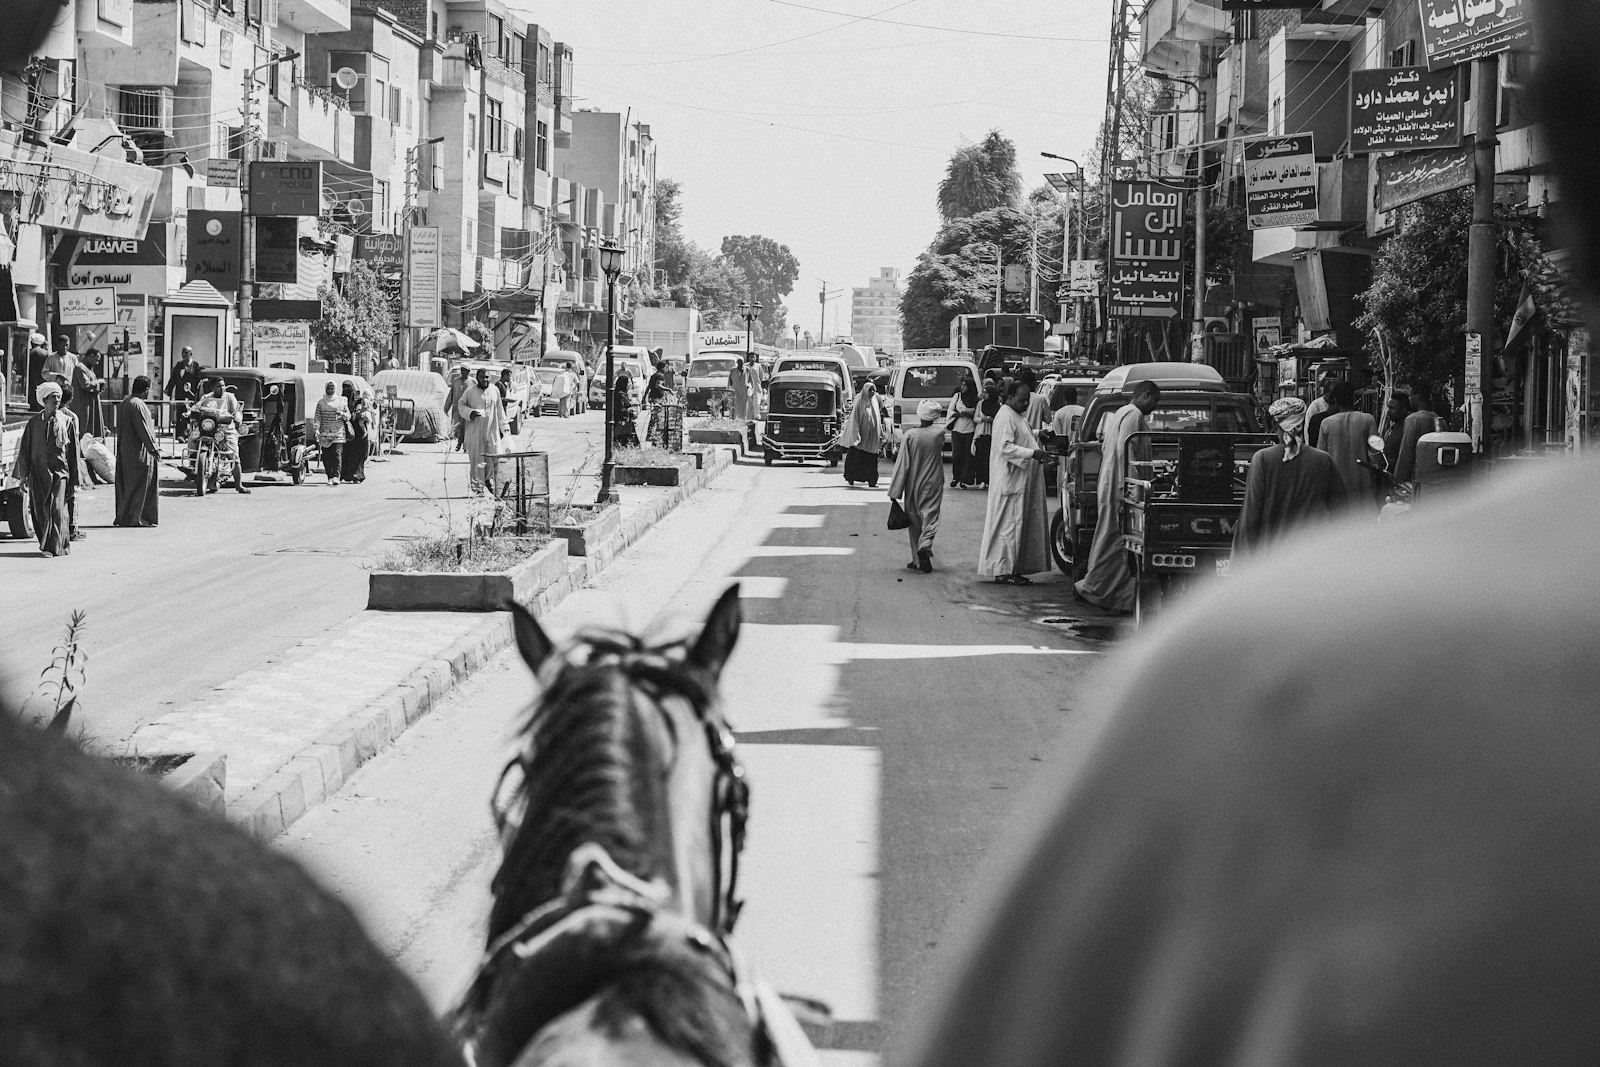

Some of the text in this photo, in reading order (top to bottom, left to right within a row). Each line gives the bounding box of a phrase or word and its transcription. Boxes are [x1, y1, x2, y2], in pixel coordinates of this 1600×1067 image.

[1436, 28, 1473, 46] الطبية
[1387, 70, 1420, 86] دكتور
[1355, 80, 1454, 109] أيمن محمد داود
[1375, 111, 1405, 123] الحميات
[1419, 121, 1430, 132] طب
[1431, 120, 1455, 131] ماجستير
[1420, 133, 1439, 142] حميات
[1257, 140, 1299, 158] دكتور
[1113, 184, 1178, 208] معامل
[1249, 193, 1269, 203] العظام
[1268, 191, 1290, 200] جراحة
[1145, 191, 1183, 233] ابن
[1281, 200, 1304, 211] والعمود
[1114, 211, 1181, 267] سينا
[1112, 269, 1180, 285] للتحاليل
[1112, 287, 1179, 305] الطبية
[705, 335, 741, 346] الشمعدان
